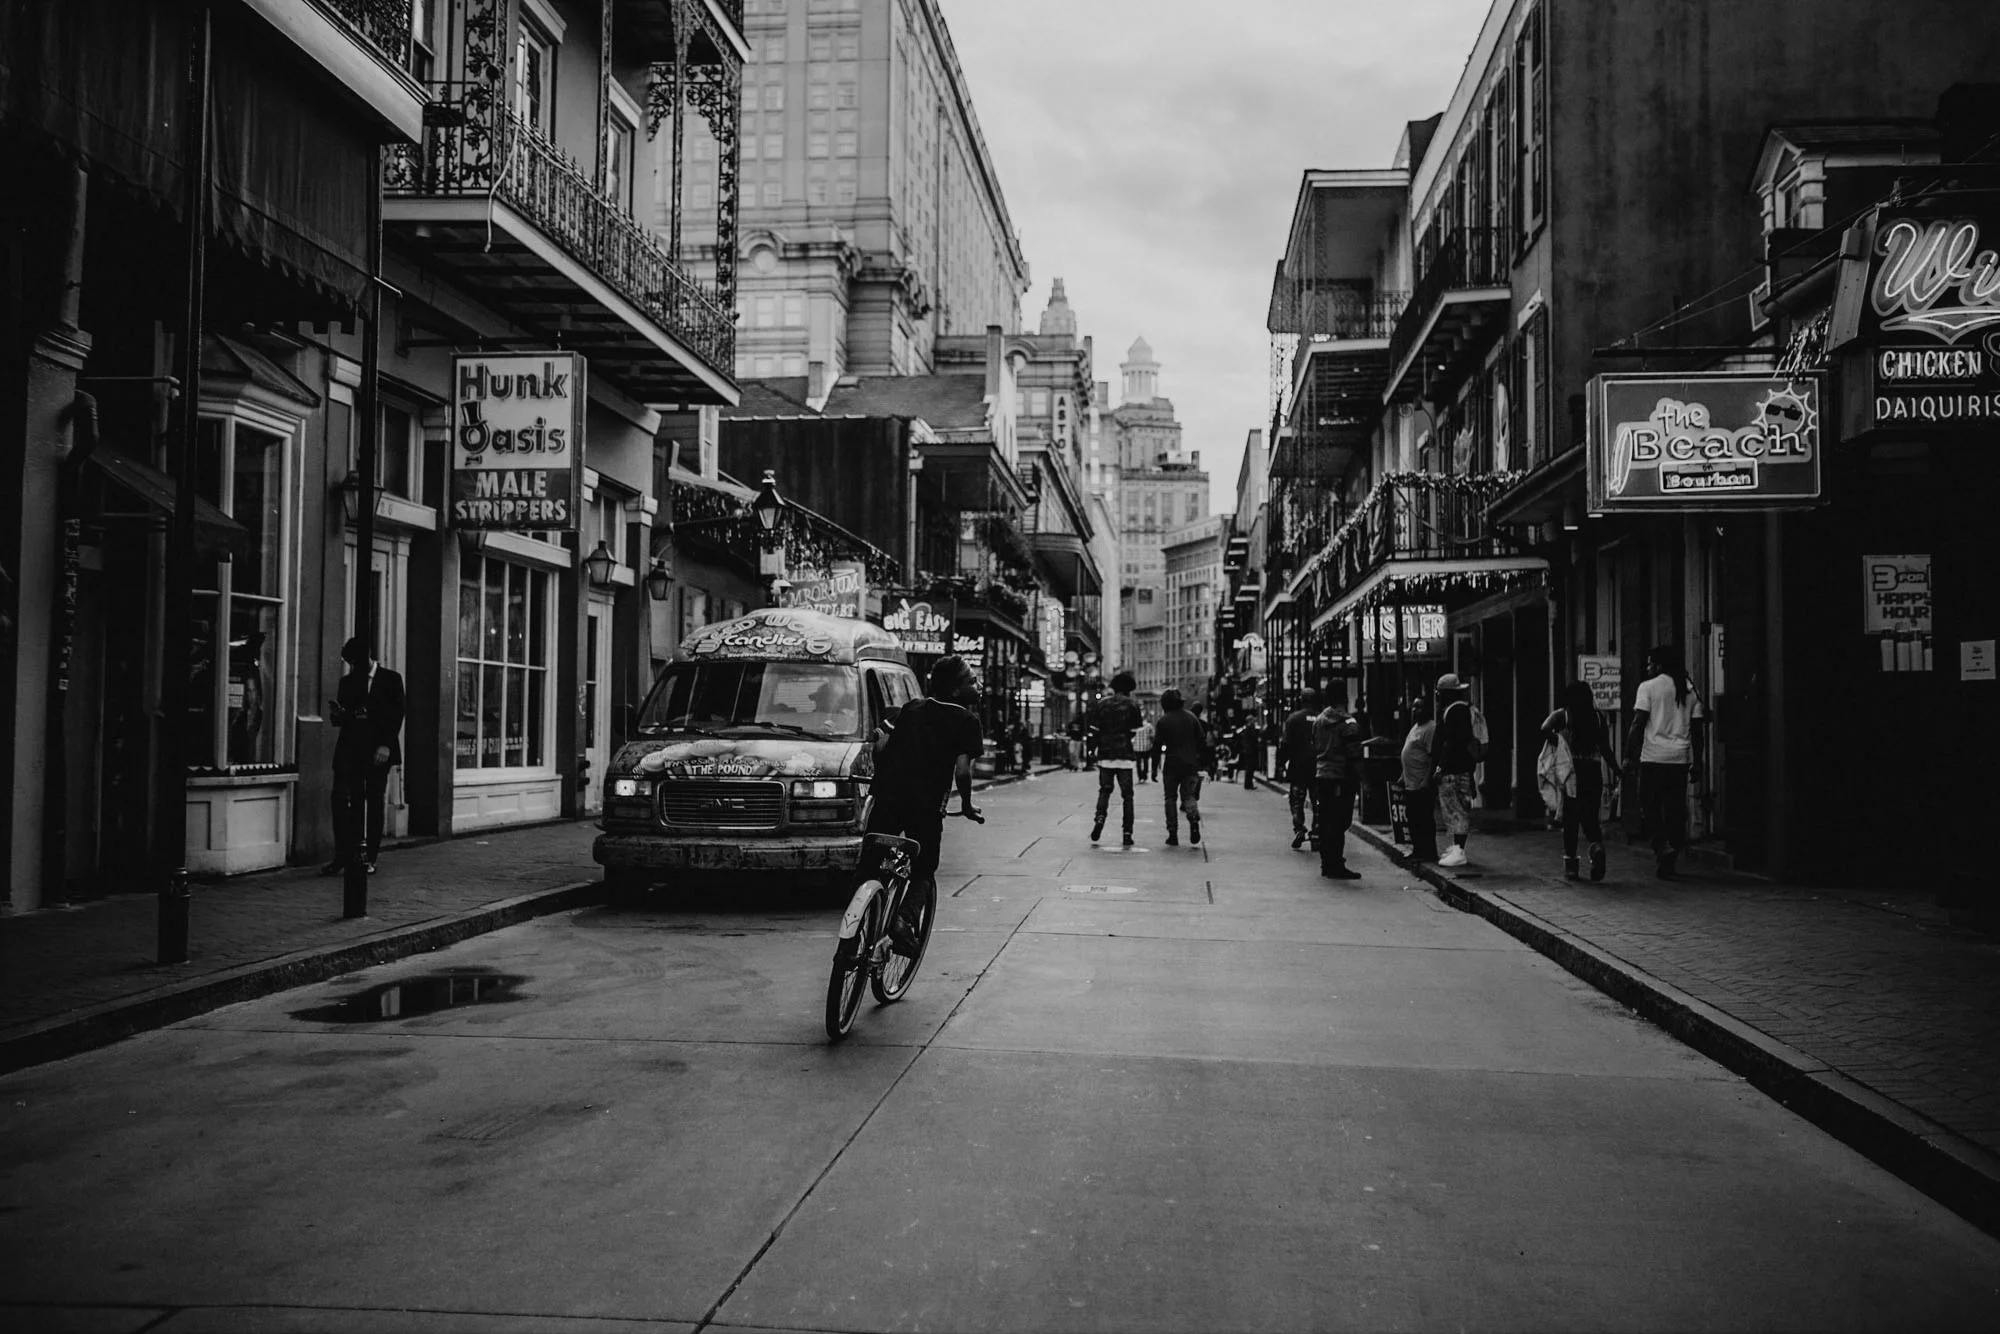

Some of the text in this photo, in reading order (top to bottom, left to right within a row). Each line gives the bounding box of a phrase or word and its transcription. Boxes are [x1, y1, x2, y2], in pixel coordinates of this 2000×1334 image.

[1880, 350, 1982, 381] CHICKEN
[460, 362, 567, 400] Hunk
[1657, 404, 1705, 436] the
[1876, 394, 2000, 422] DAIQUIRIS
[459, 416, 566, 455] Oasis
[1632, 423, 1807, 461] Beach
[475, 471, 547, 499] MALE
[1666, 472, 1752, 489] Bourbon
[455, 498, 567, 521] STRIPPERS
[883, 608, 950, 632] BIG EASY
[1883, 606, 1929, 618] HOUR
[723, 633, 808, 649] Candies
[692, 763, 753, 776] THE POUND
